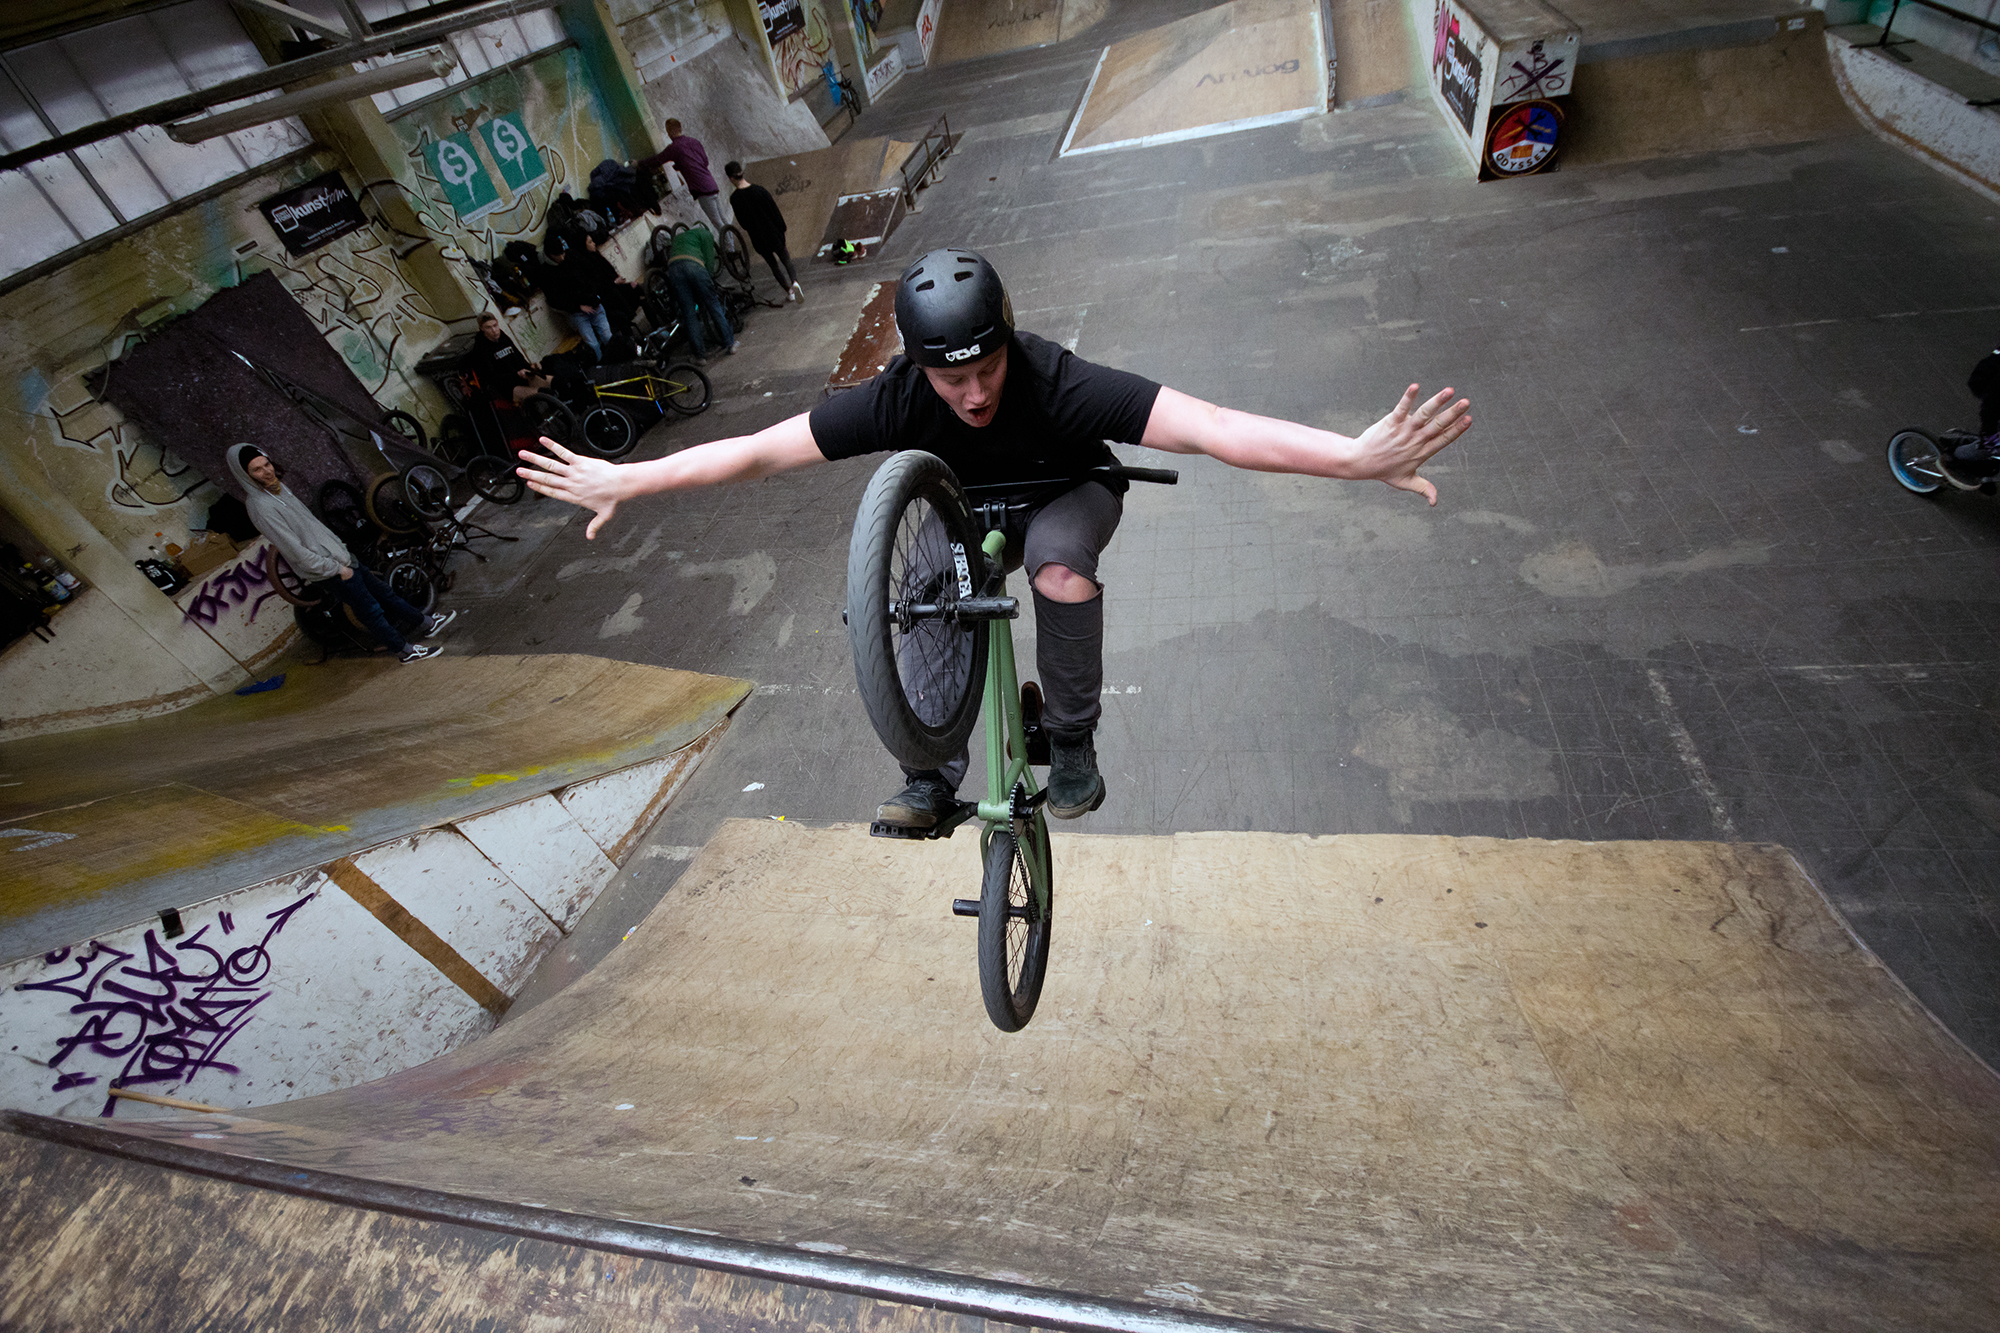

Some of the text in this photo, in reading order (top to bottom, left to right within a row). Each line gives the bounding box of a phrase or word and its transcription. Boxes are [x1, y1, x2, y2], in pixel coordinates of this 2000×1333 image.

[1496, 146, 1548, 170] ODYSSEY
[289, 187, 348, 219] kunstform
[952, 344, 981, 360] TSG
[950, 542, 973, 599] SUBROSA
